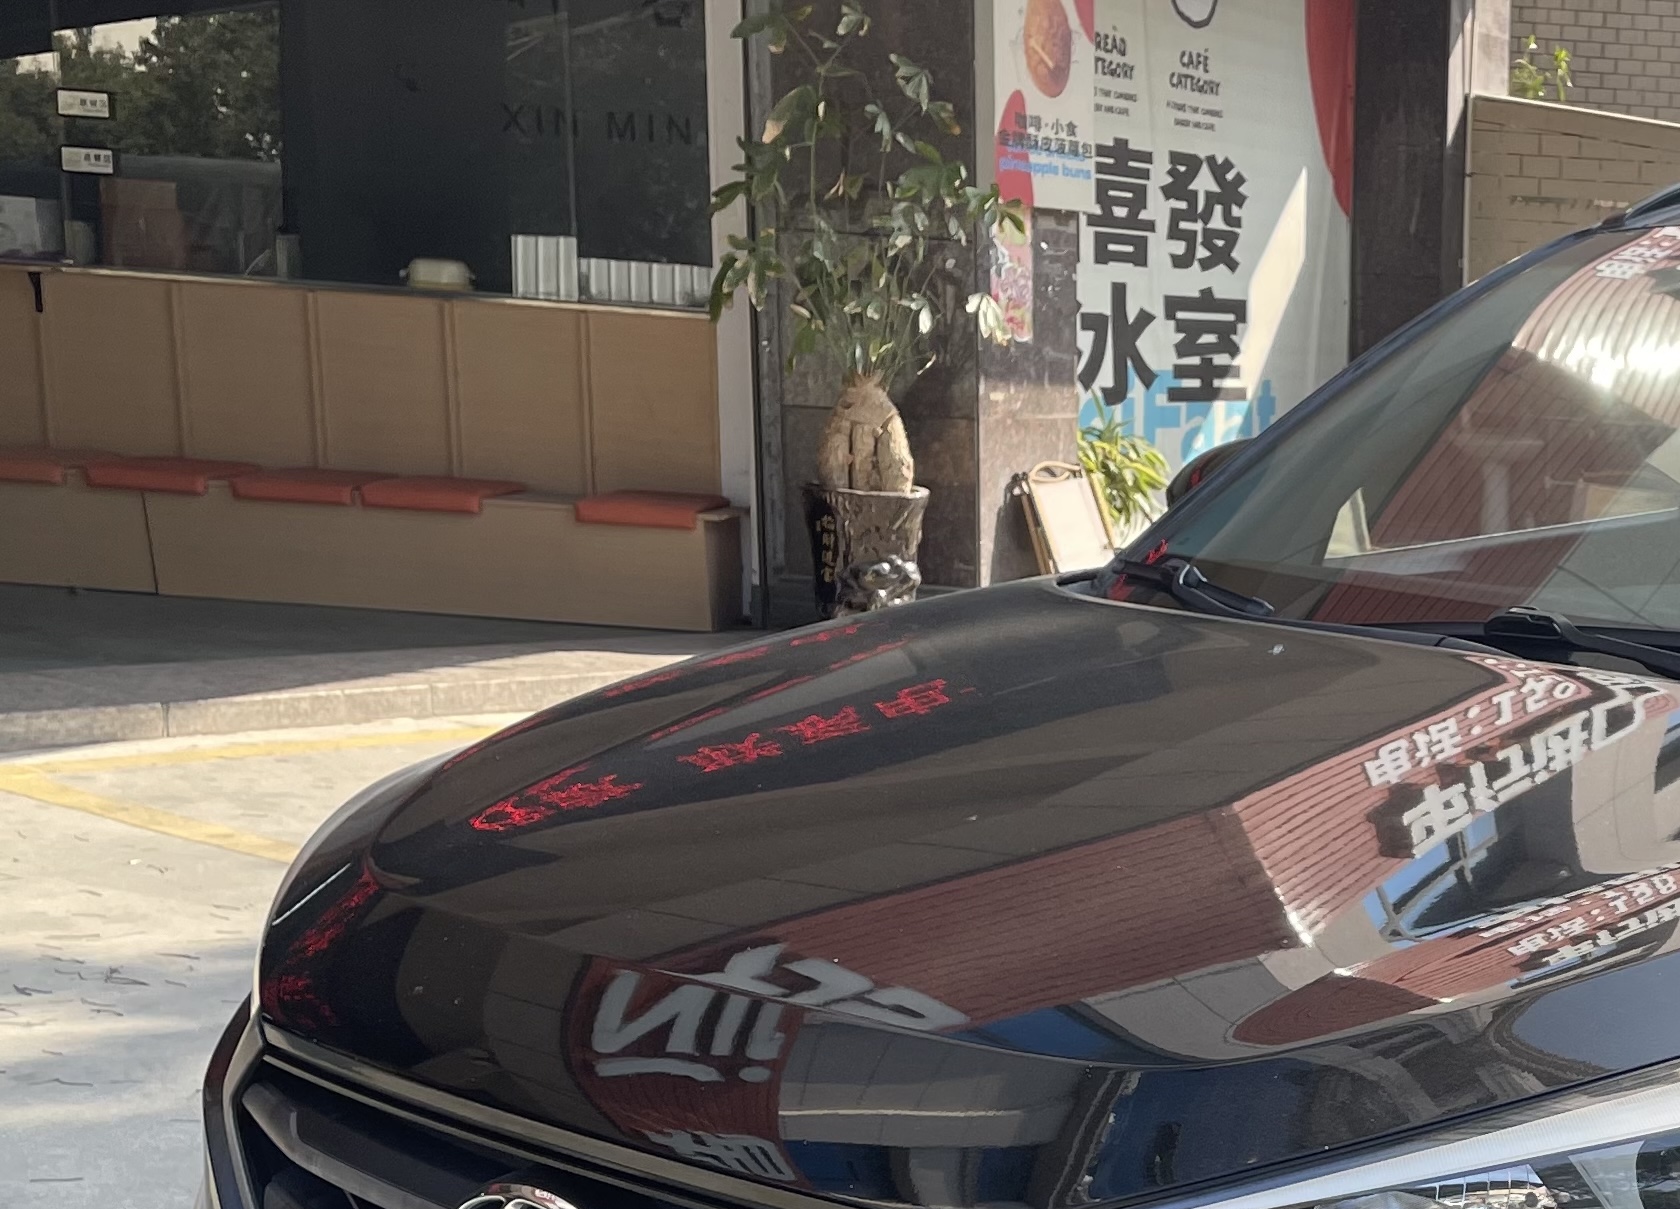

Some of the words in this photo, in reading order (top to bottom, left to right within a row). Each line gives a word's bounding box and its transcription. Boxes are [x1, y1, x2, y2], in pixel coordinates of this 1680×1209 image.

[1094, 31, 1127, 57] READ
[1094, 55, 1135, 80] TEGORY
[1169, 72, 1221, 96] CATEGORY
[500, 102, 578, 138] XIN
